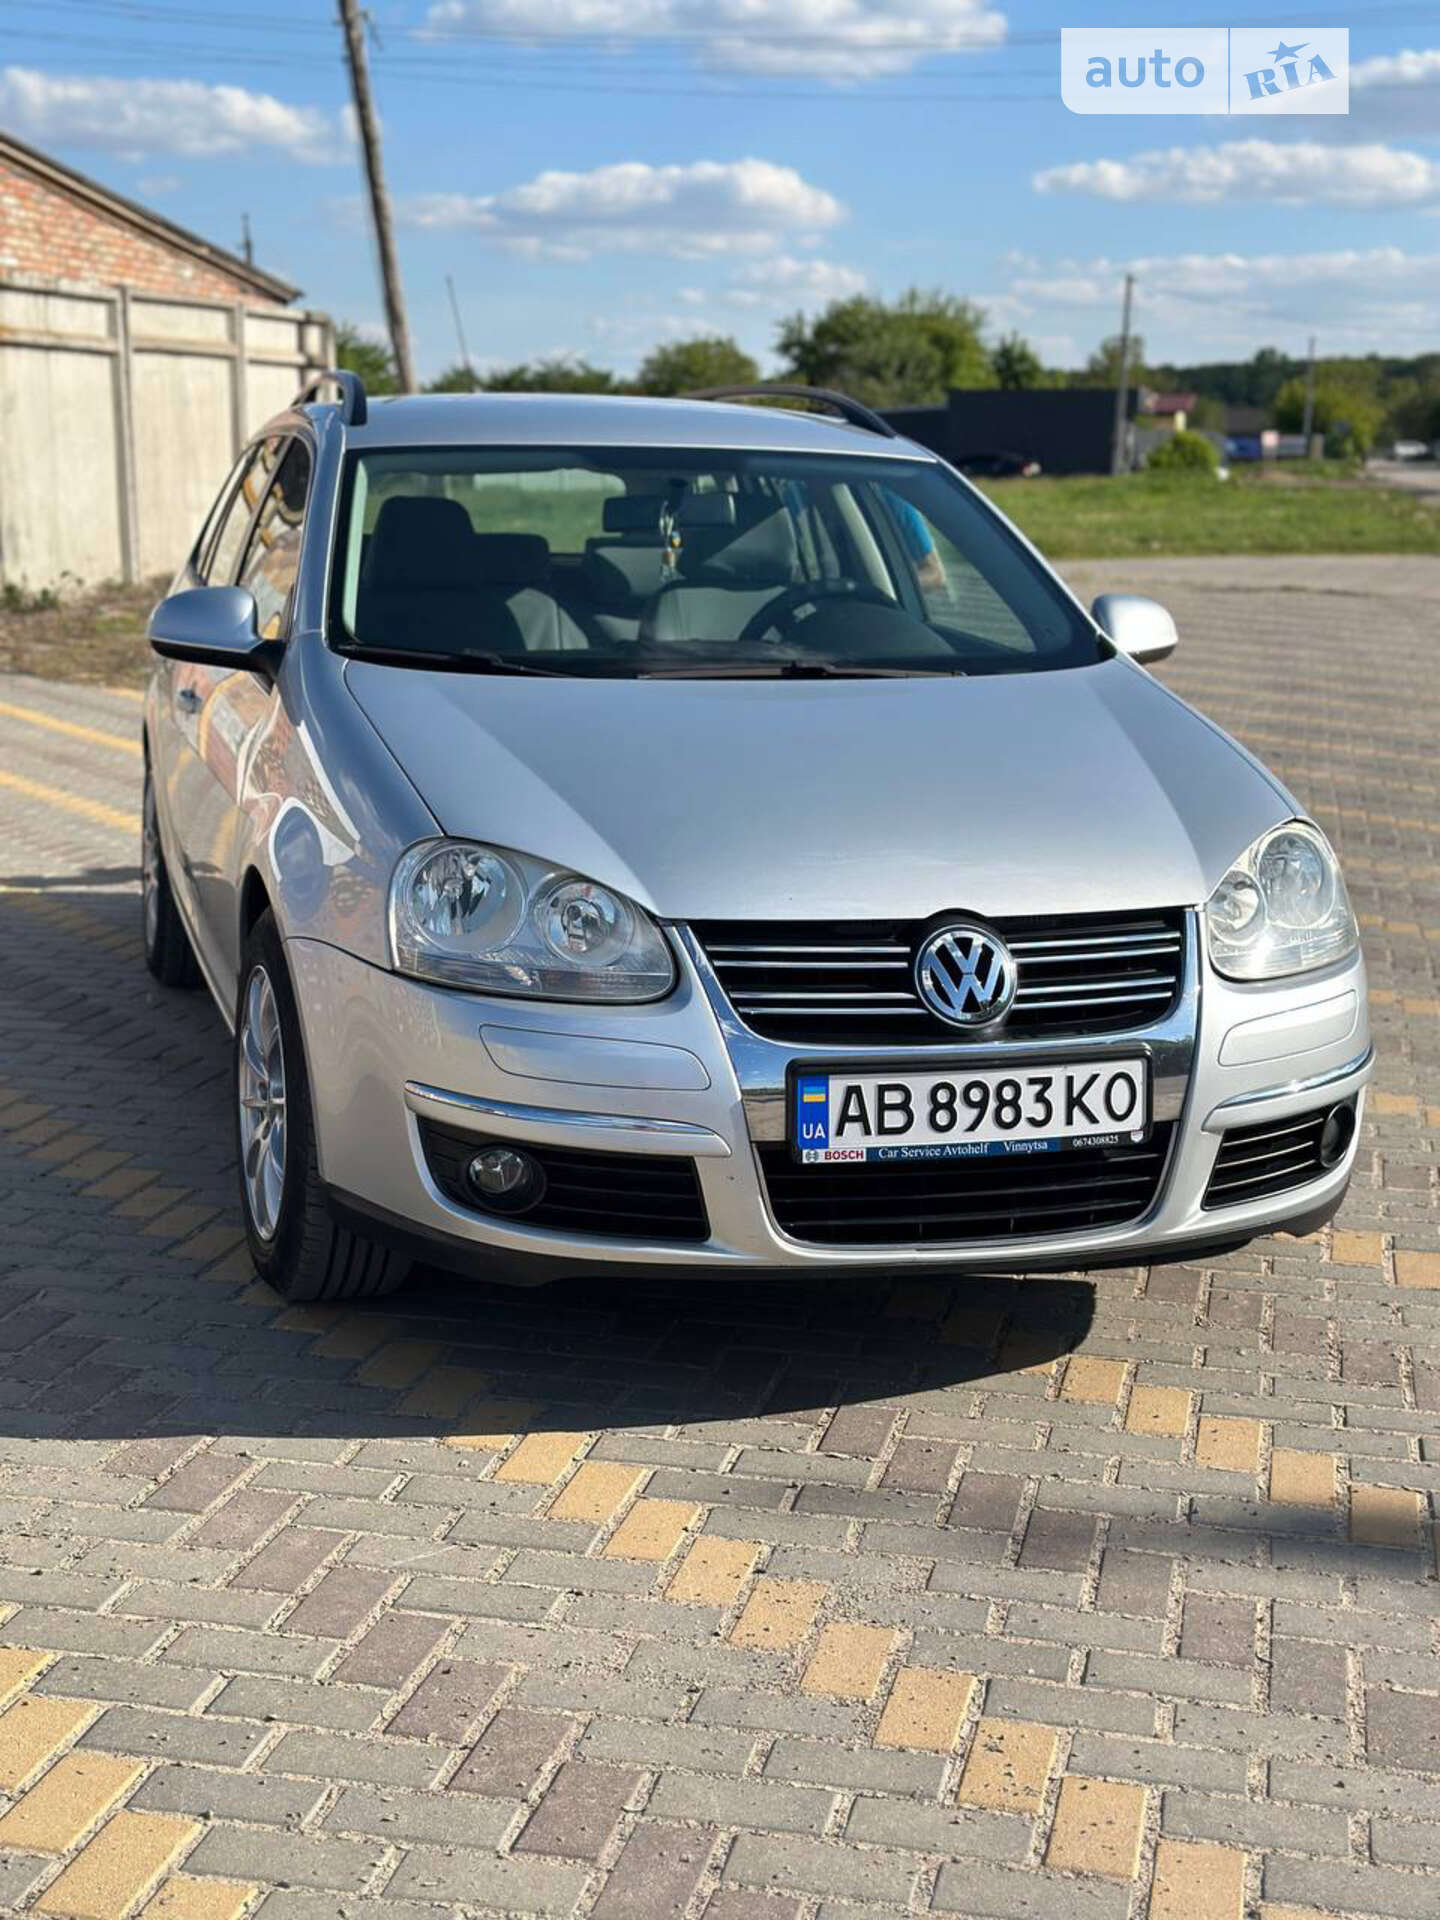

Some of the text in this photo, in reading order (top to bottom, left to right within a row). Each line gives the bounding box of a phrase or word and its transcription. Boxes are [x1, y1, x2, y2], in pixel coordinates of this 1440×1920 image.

[834, 1070, 1138, 1138] AB 8983 KO
[802, 1123, 827, 1140] UA
[823, 1149, 865, 1162] BOSCH
[878, 1147, 899, 1159] Car
[901, 1145, 942, 1158] Service
